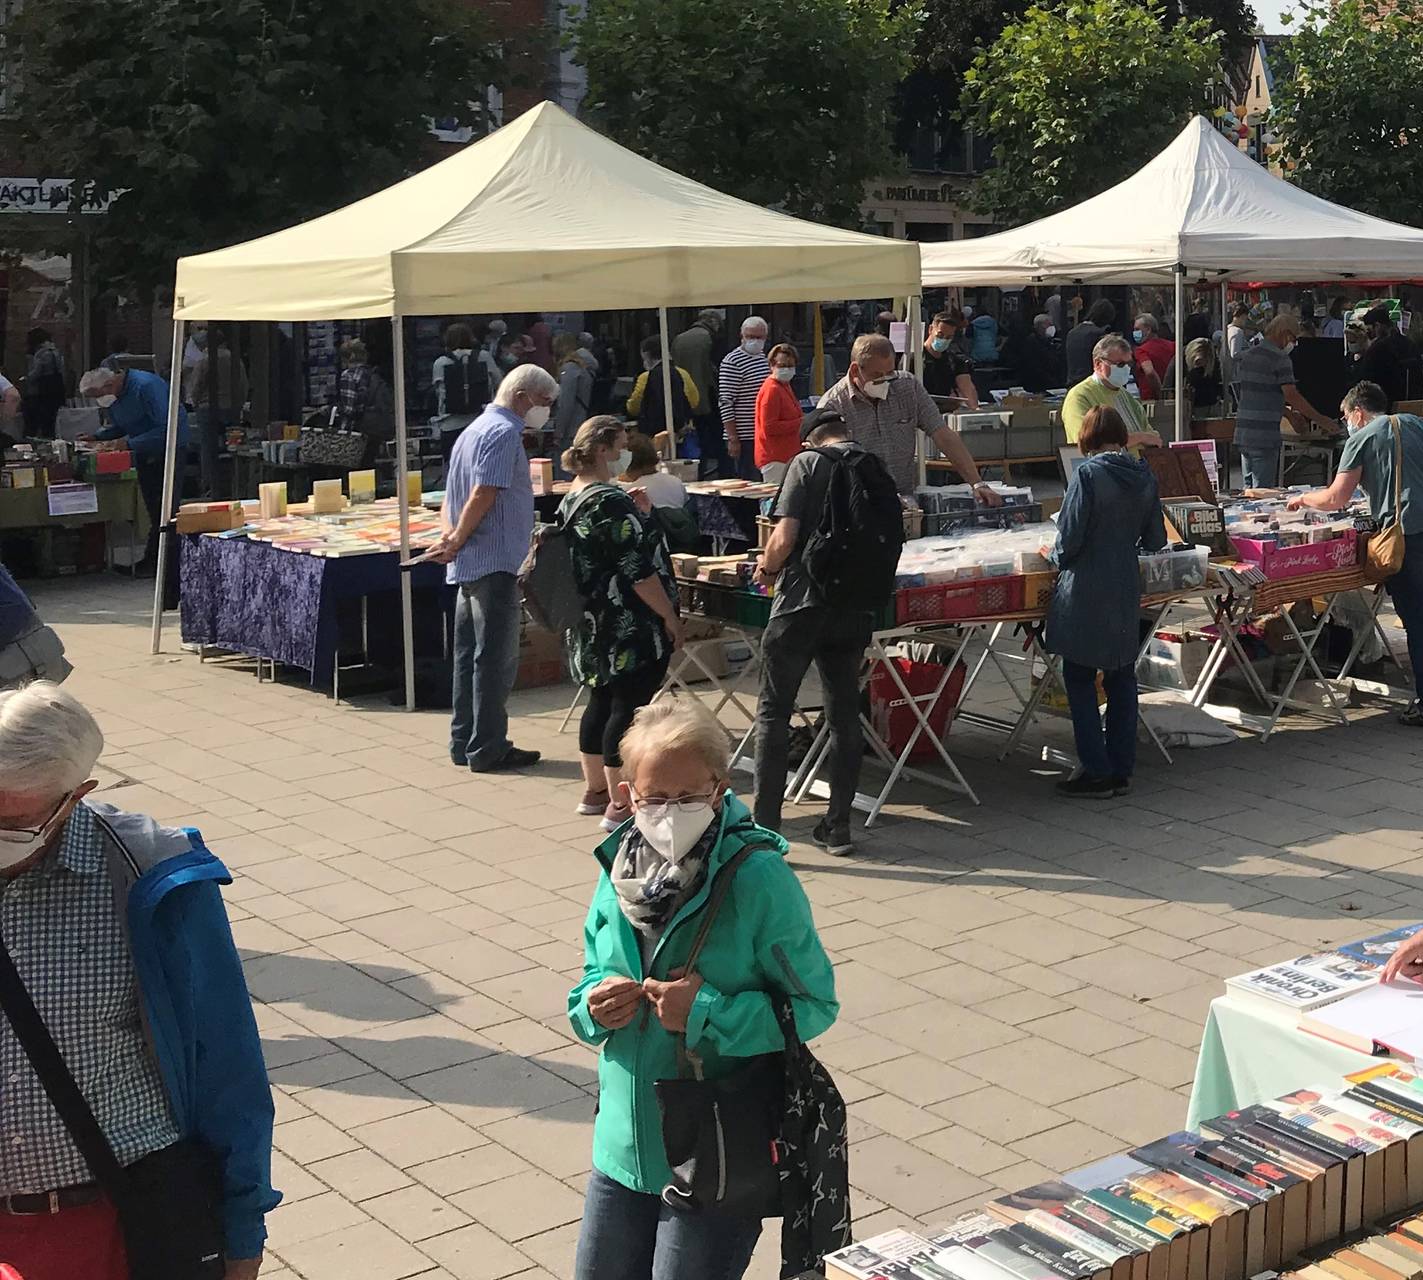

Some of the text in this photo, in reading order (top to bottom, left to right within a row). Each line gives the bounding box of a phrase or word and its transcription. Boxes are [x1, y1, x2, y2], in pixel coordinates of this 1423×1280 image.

[1194, 510, 1217, 522] Bild
[1190, 522, 1222, 533] atlas
[1250, 972, 1319, 1000] Chronik
[1281, 970, 1341, 994] Berlin
